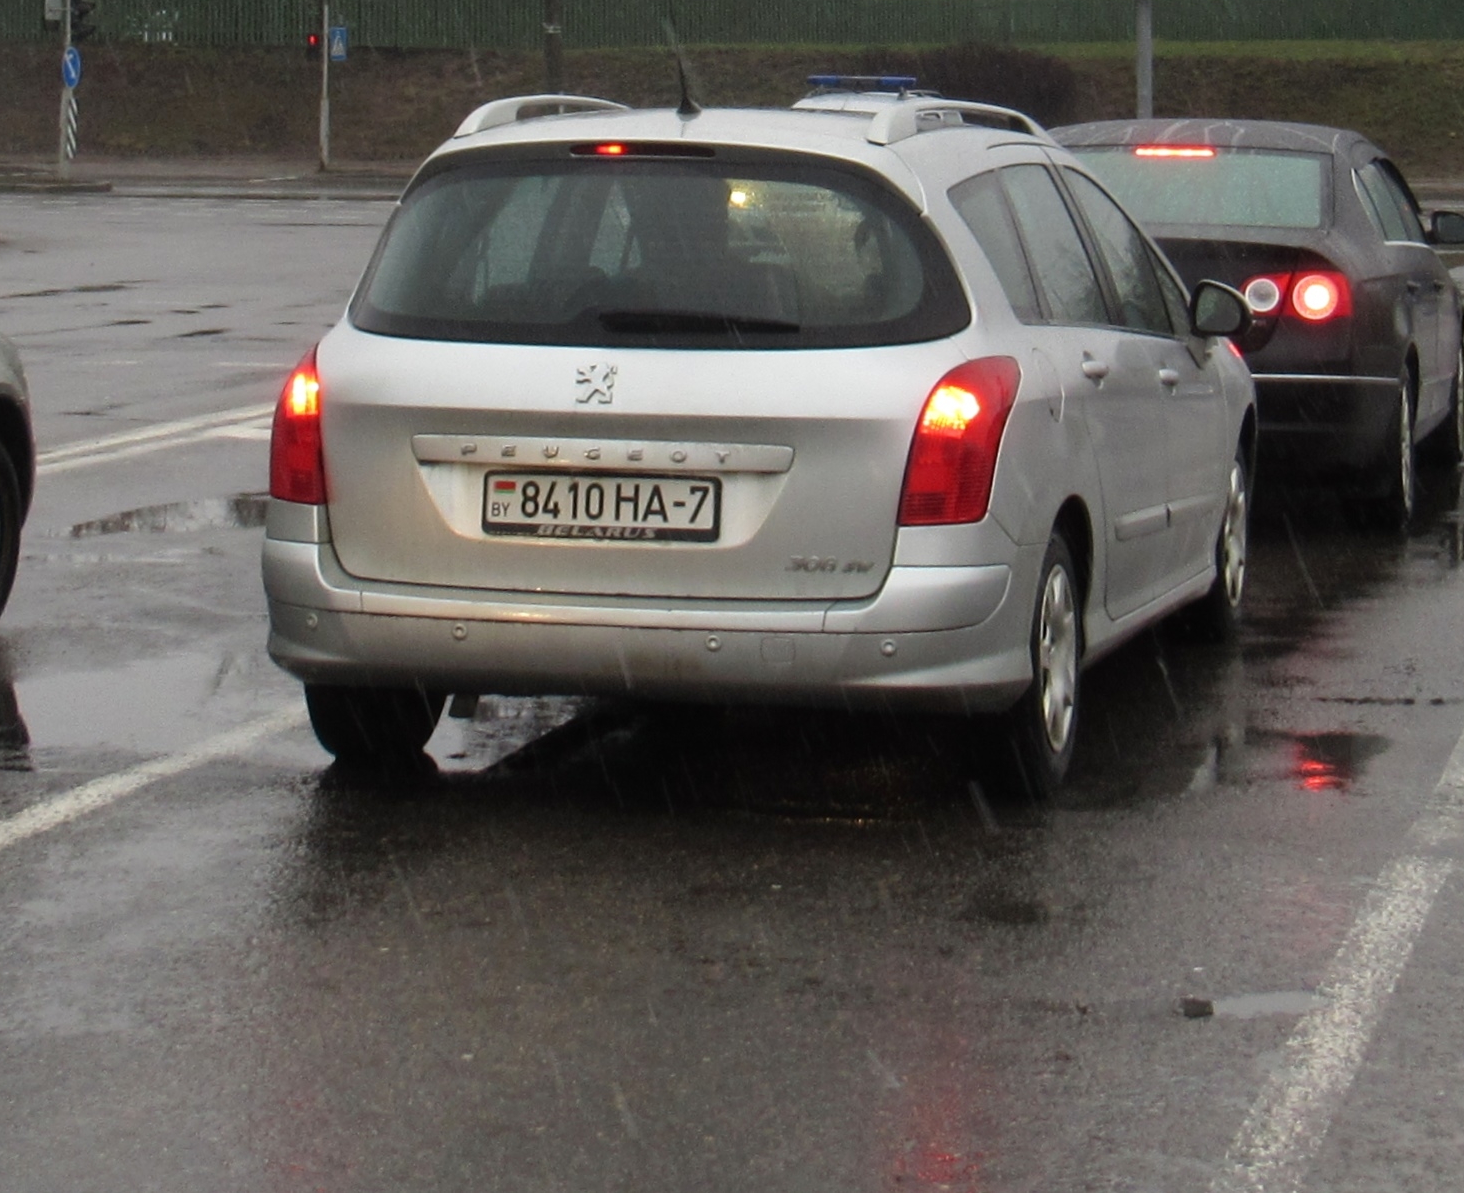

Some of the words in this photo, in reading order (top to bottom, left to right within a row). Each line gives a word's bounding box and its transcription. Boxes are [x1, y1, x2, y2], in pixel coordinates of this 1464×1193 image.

[461, 441, 731, 465] PEUGEOT
[491, 502, 511, 518] BY
[520, 480, 605, 521] 8410
[614, 482, 710, 524] HA-7
[535, 524, 656, 539] BELARUS
